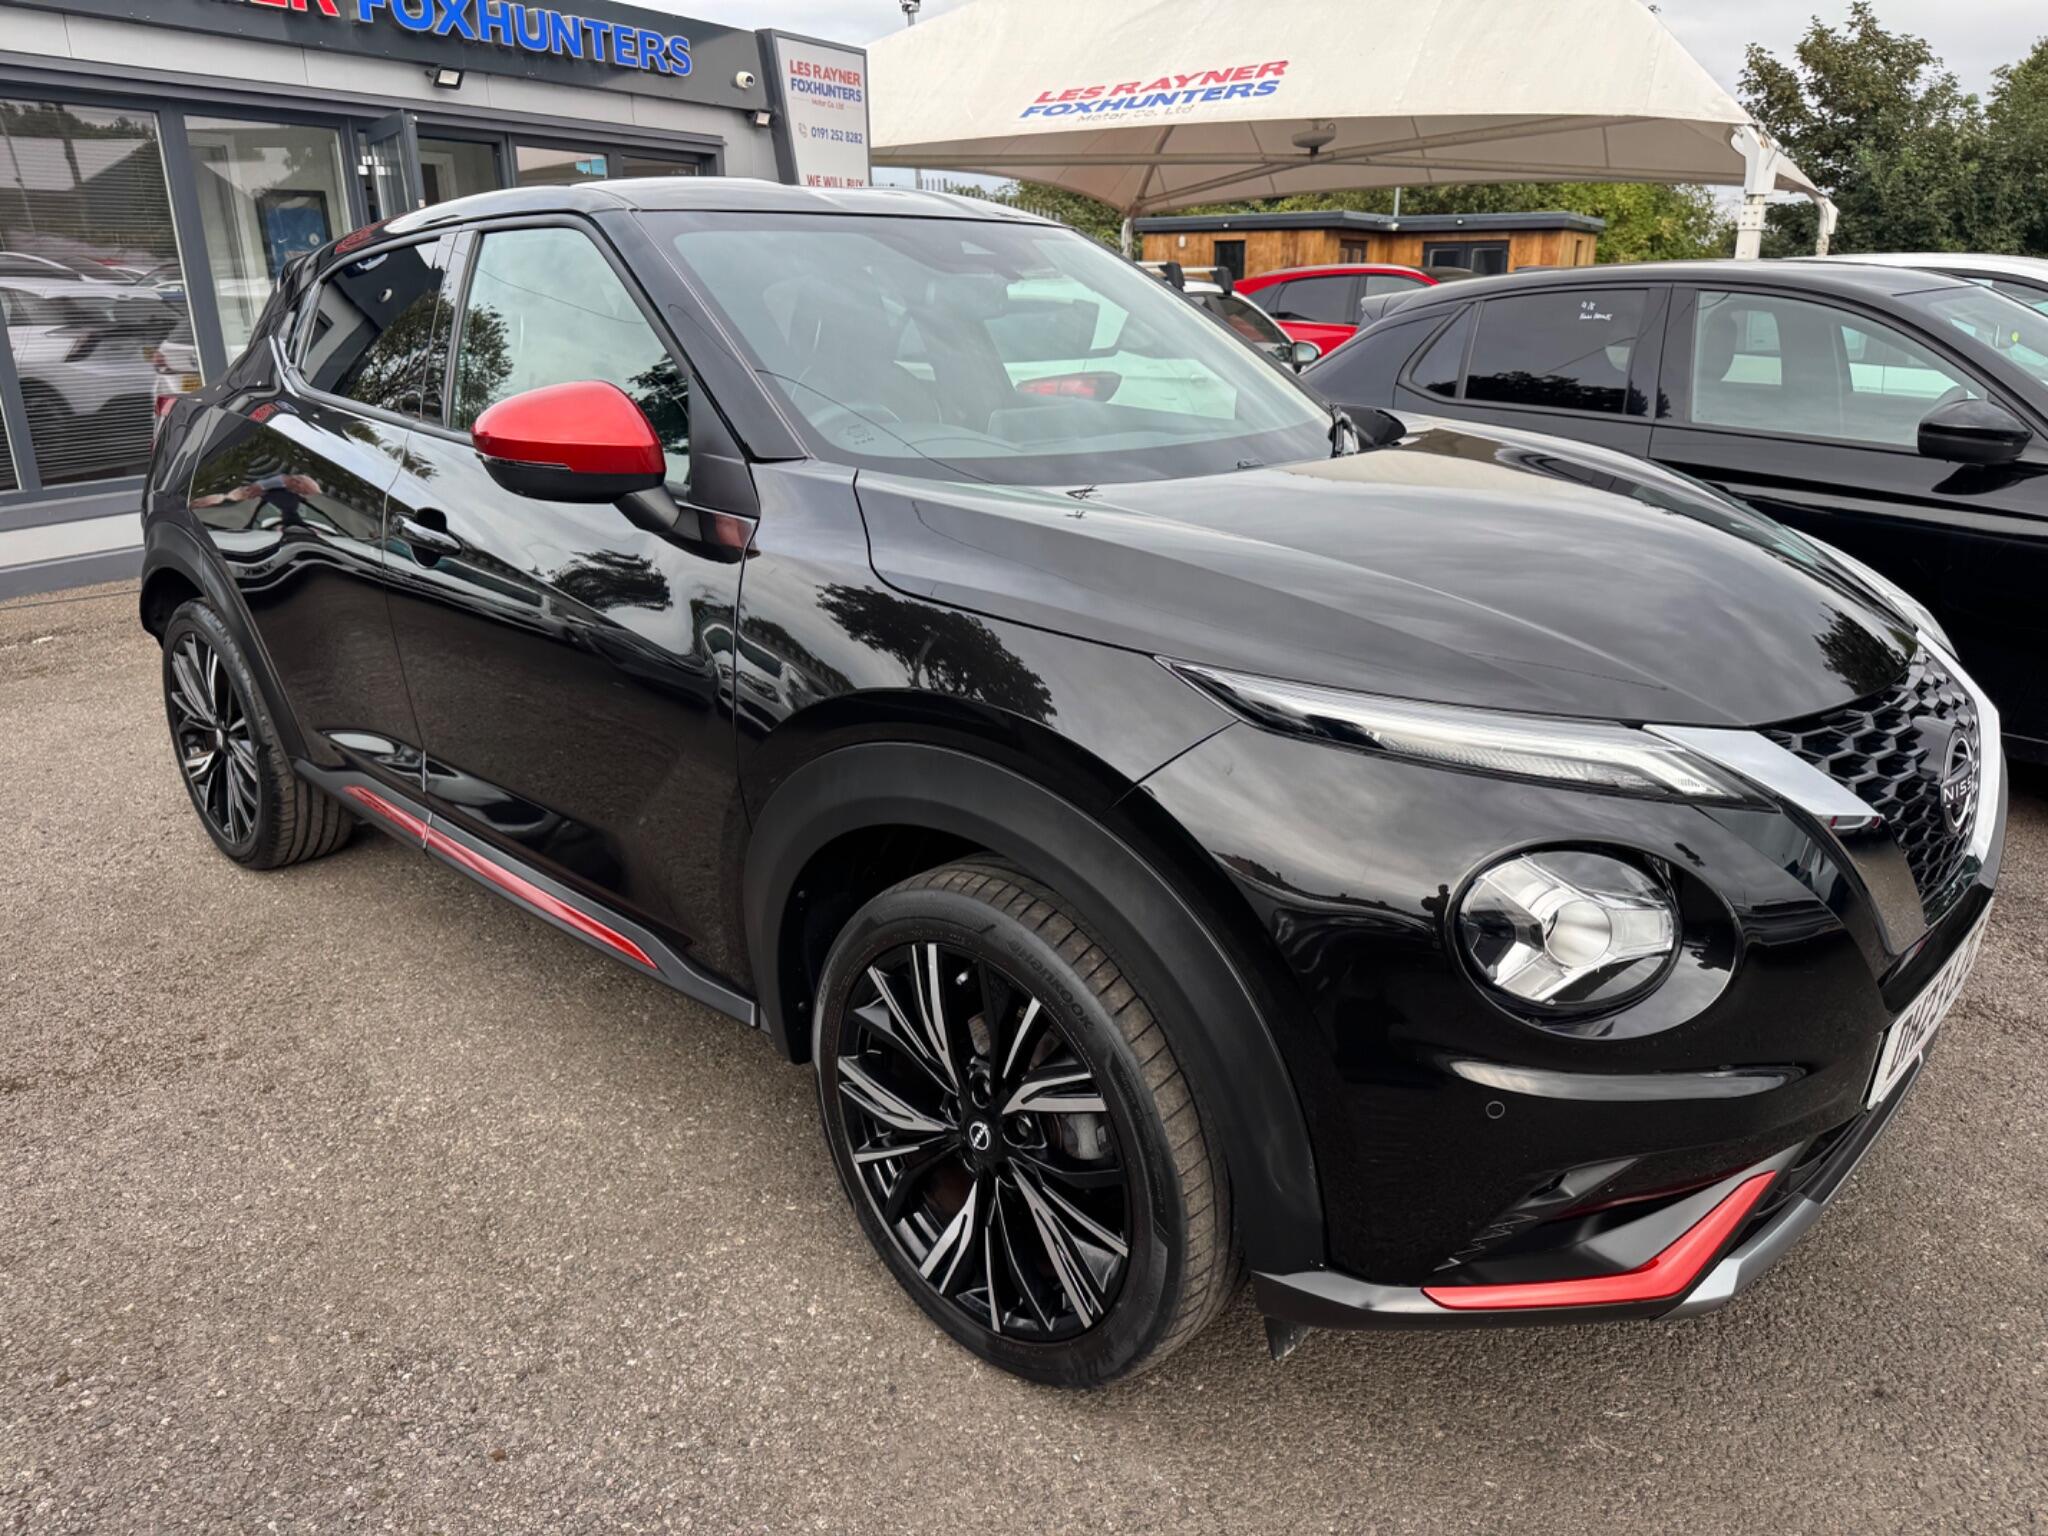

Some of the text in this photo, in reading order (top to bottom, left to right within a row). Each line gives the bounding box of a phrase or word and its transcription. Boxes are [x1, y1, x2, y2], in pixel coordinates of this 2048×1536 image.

[790, 59, 862, 87] LES RAYNER
[1034, 60, 1289, 104] LES RAYNER
[790, 77, 863, 103] FOXHUNTERS
[1019, 80, 1281, 118] FOXHUNTERS
[1077, 112, 1128, 122] Motor
[1164, 104, 1195, 115] Ltd
[811, 126, 863, 145] 0191 252 8282
[806, 174, 821, 187] WE
